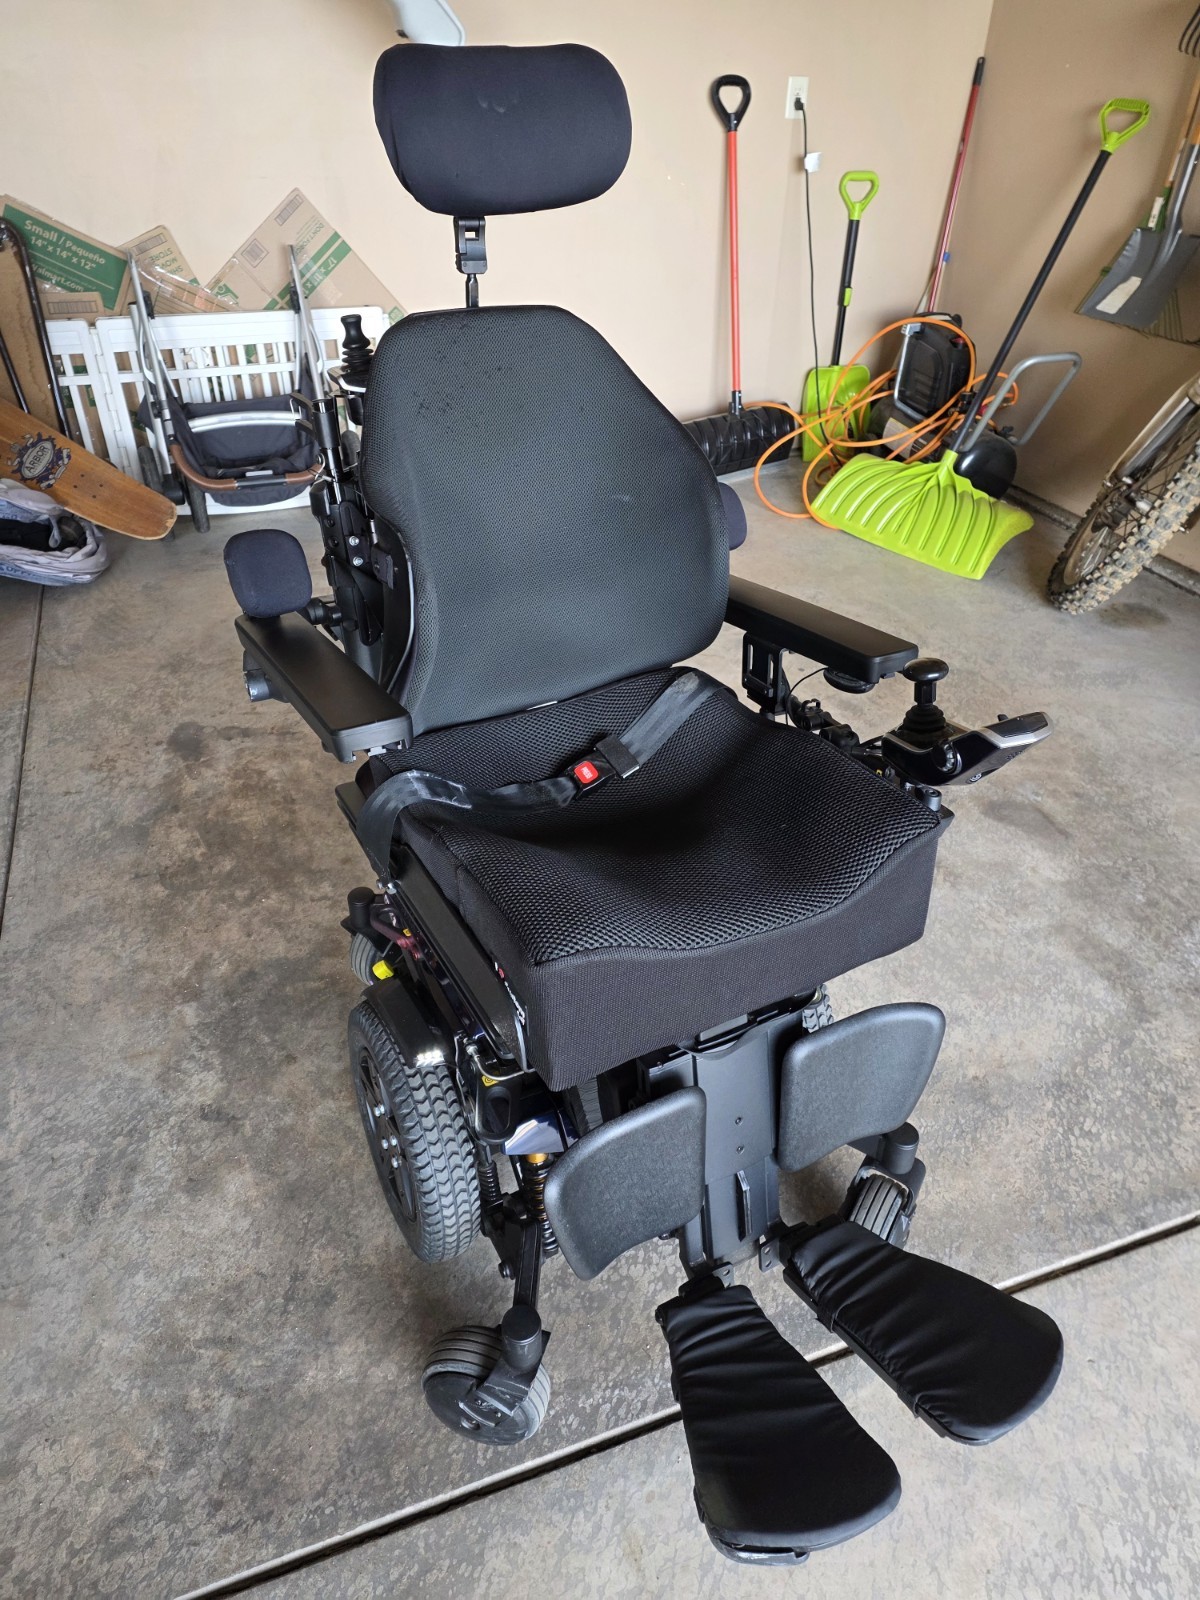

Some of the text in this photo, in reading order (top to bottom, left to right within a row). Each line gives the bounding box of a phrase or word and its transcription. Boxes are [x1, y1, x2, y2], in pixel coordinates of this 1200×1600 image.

[24, 220, 58, 242] Small
[65, 240, 106, 265] Pequeño
[31, 236, 47, 247] 14"
[80, 259, 96, 271] 12"
[149, 247, 173, 262] STORE
[25, 445, 49, 473] ARBOR
